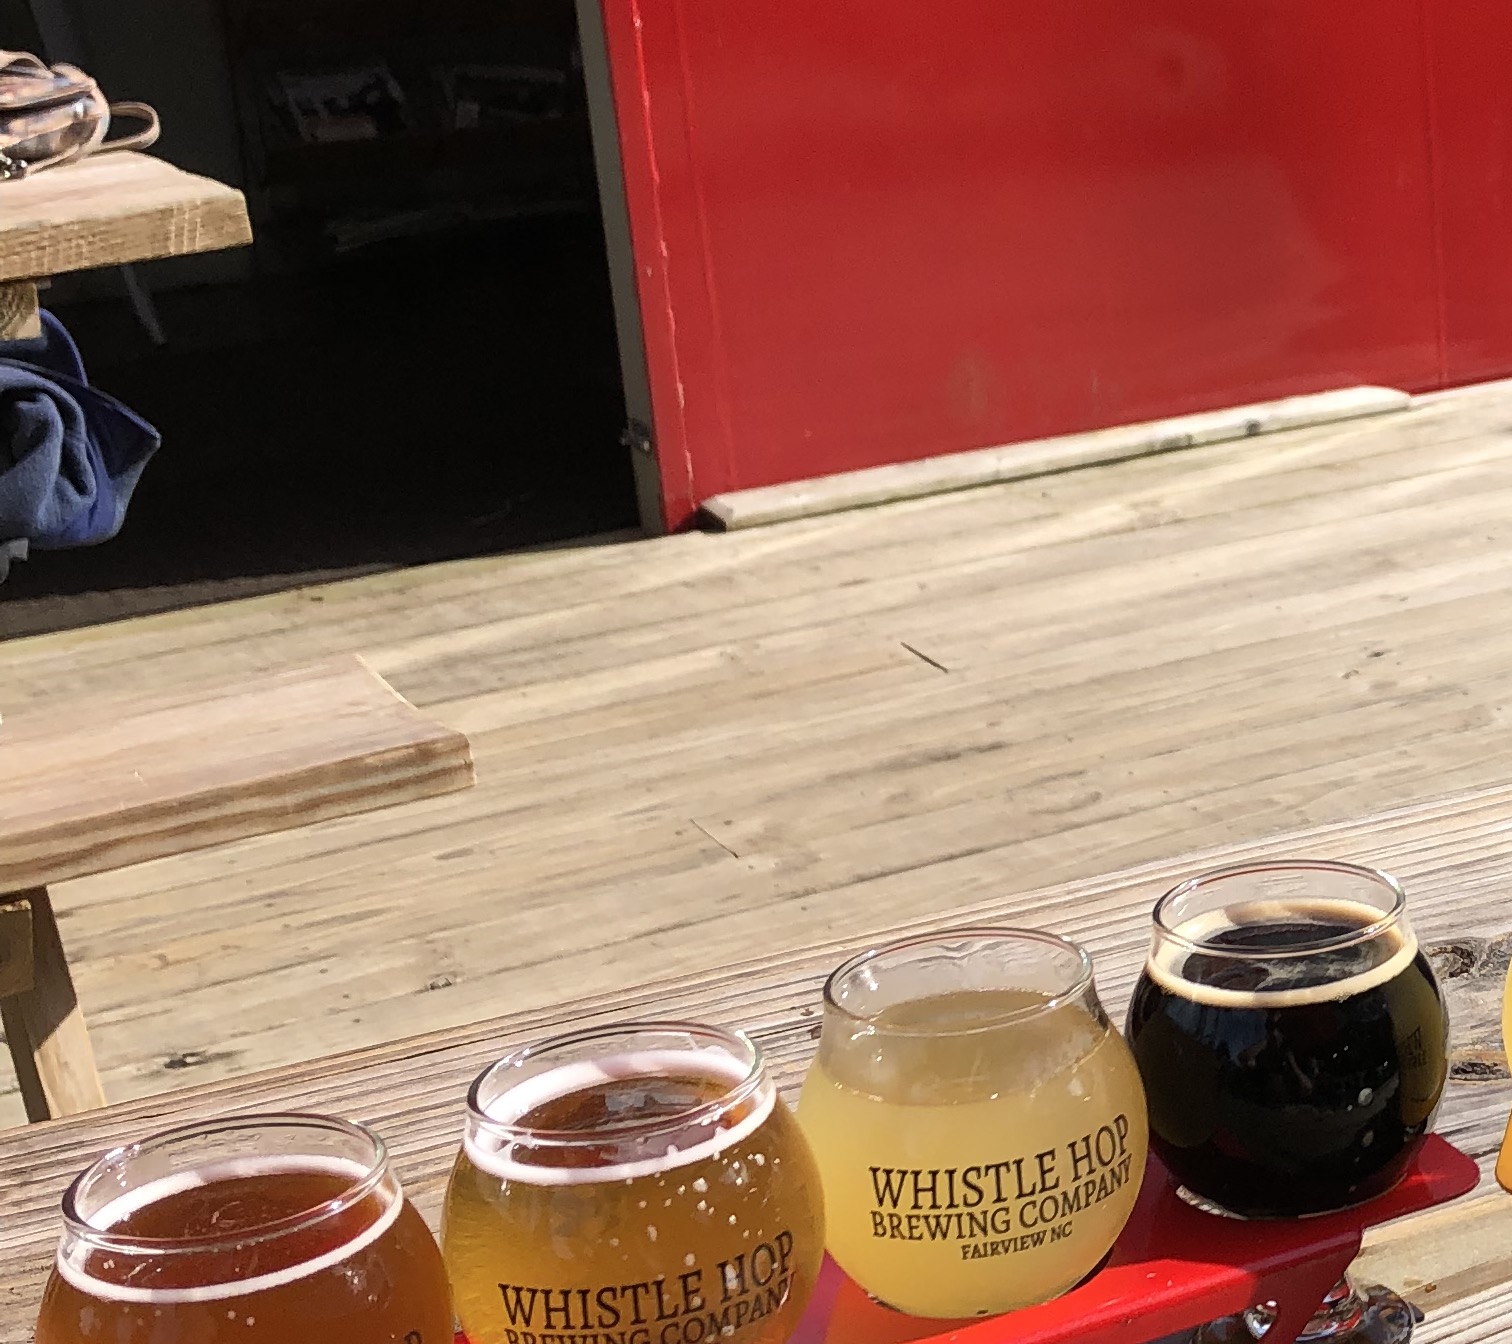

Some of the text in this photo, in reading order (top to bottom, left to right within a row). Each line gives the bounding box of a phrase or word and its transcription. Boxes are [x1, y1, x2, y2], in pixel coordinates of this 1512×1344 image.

[869, 1113, 1129, 1210] WHISTLE HOP
[870, 1154, 1132, 1241] BREWING COMPANY
[498, 1230, 793, 1330] WHISTLE HOP
[961, 1220, 1073, 1260] FAIRVIEW NC
